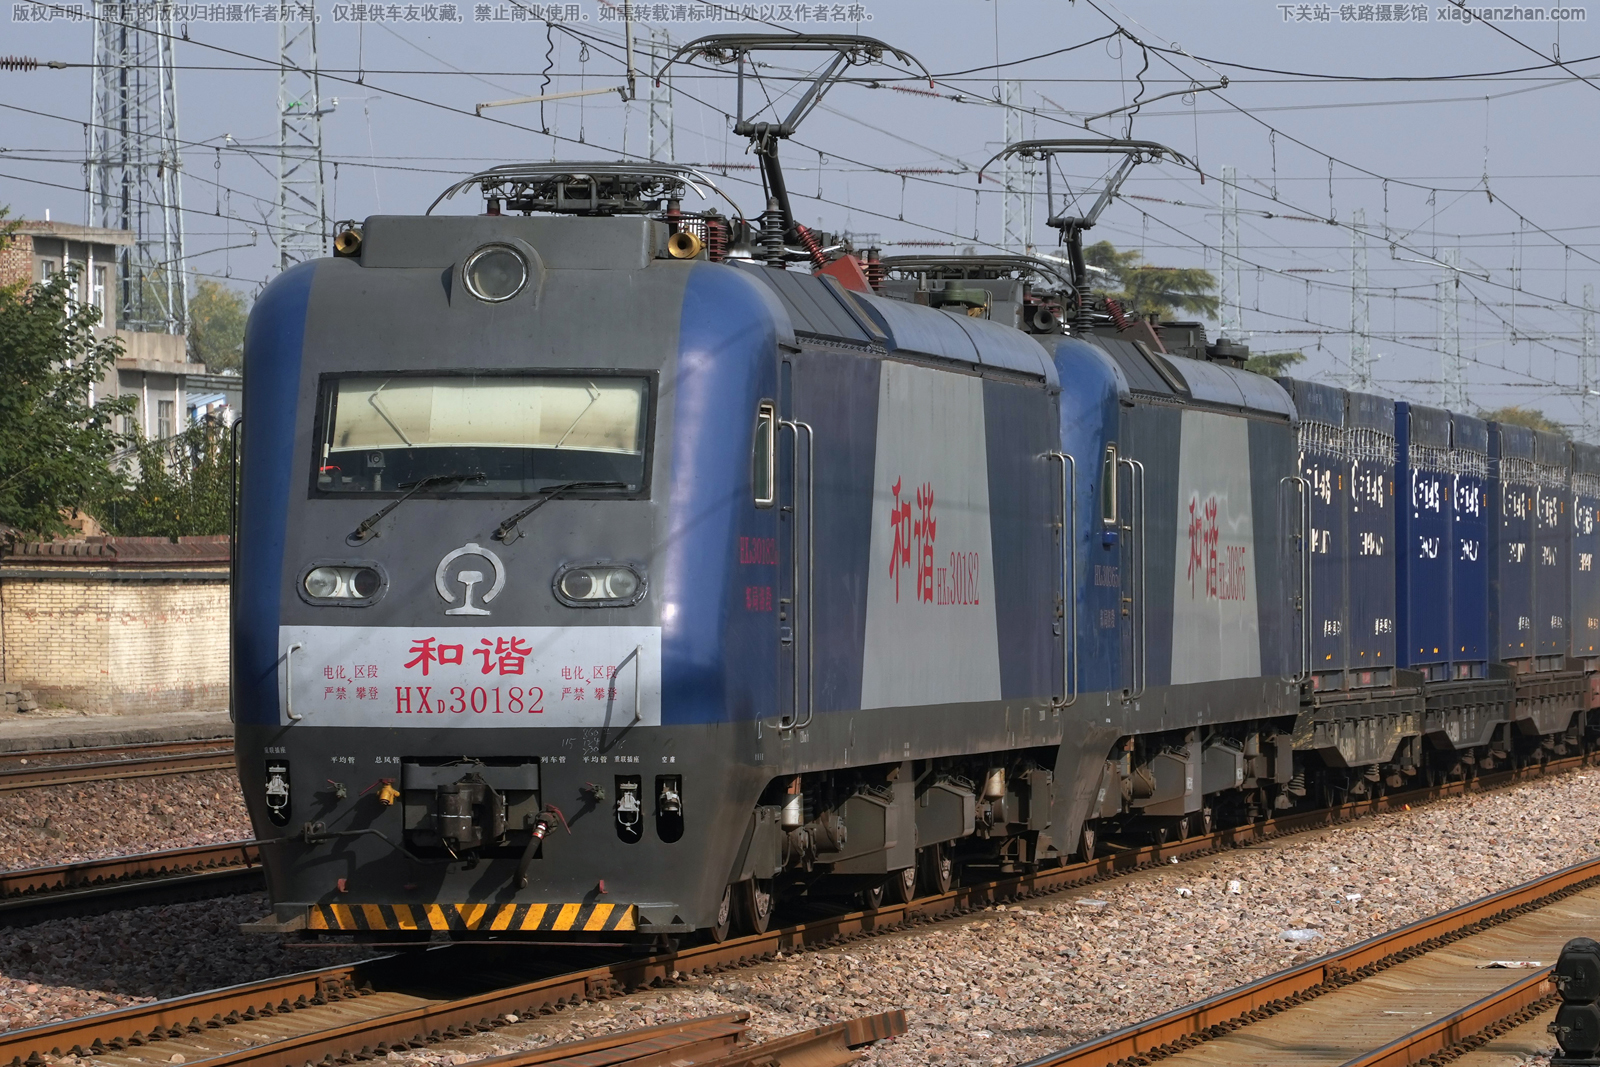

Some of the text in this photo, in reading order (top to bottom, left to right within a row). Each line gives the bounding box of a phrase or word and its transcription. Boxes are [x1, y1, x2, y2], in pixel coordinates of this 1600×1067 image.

[889, 475, 980, 605] 和谐 HXD30182
[1187, 496, 1219, 600] 和谐
[403, 636, 533, 676] 和谐
[395, 686, 544, 714] HXD30182
[331, 756, 356, 764] 平均管
[374, 756, 400, 764] 总风管
[541, 756, 566, 764] 列车管
[583, 756, 608, 764] 平均管
